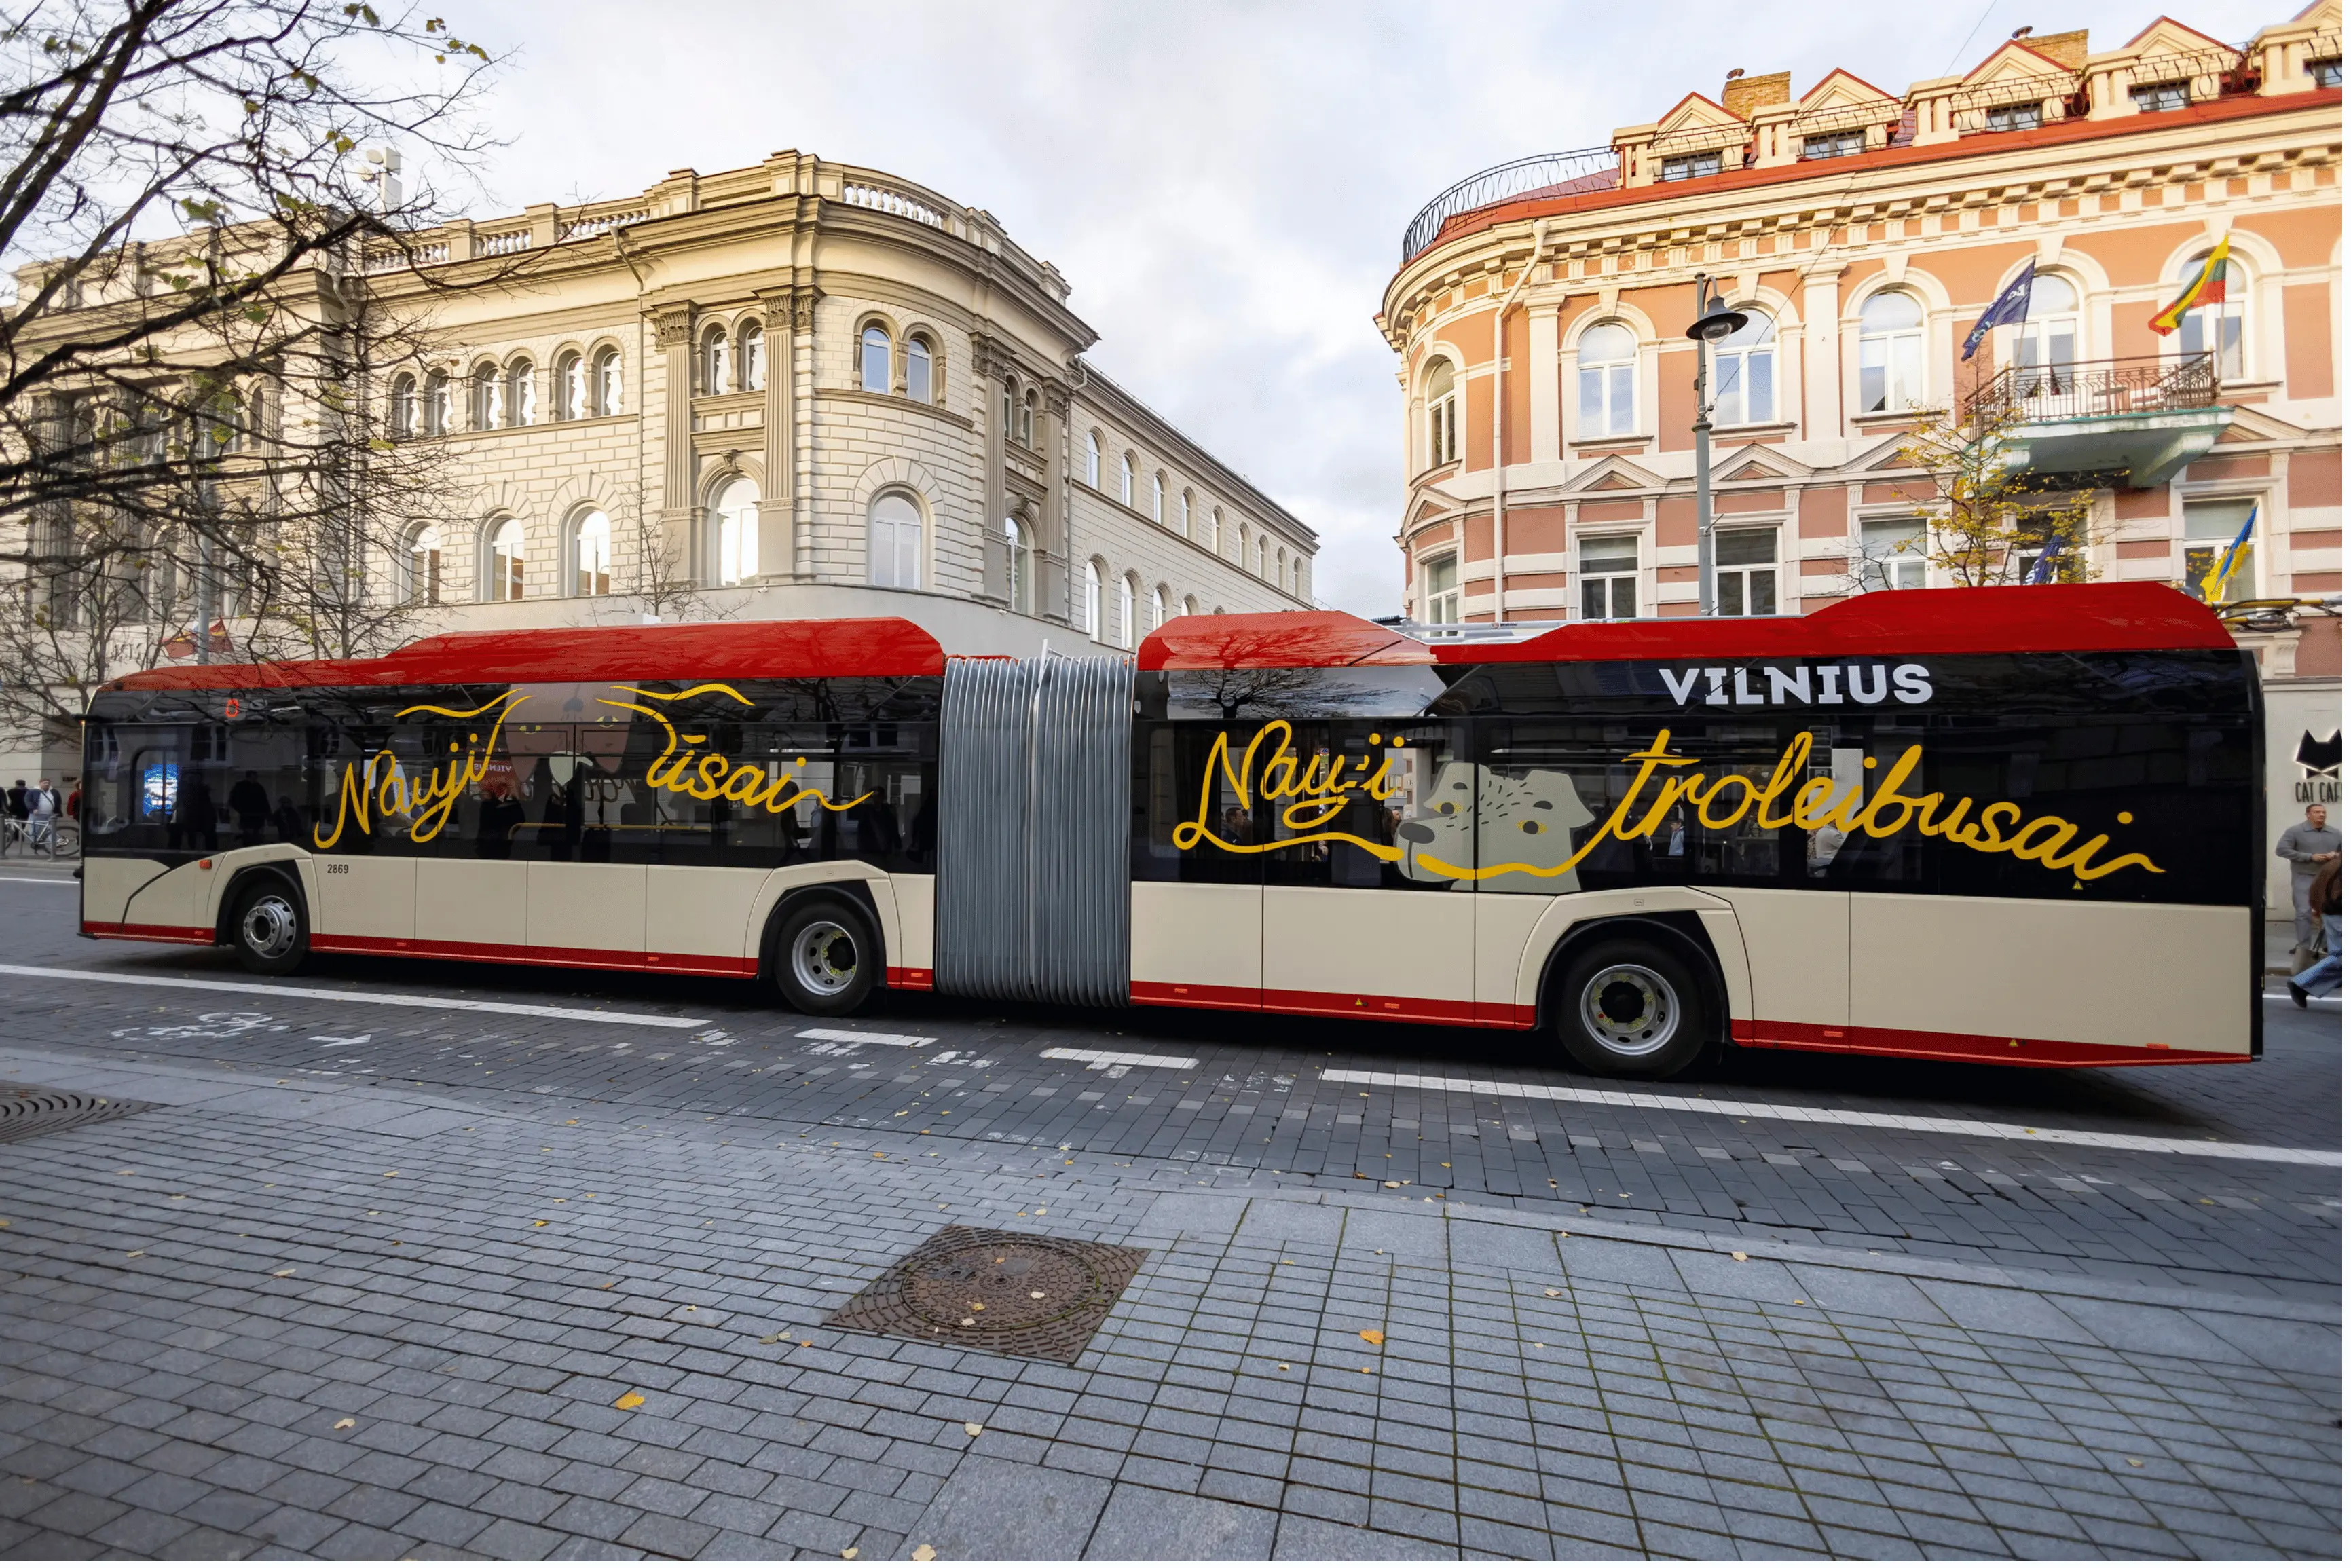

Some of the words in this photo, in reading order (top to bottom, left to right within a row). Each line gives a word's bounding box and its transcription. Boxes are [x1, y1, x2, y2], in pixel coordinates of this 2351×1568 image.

[1659, 663, 1933, 706] VILNIUS
[314, 713, 517, 848] Nauji
[2295, 781, 2314, 802] CAT
[2319, 781, 2342, 803] CAF
[1599, 729, 2164, 880] troleibusai
[327, 863, 349, 874] 2869
